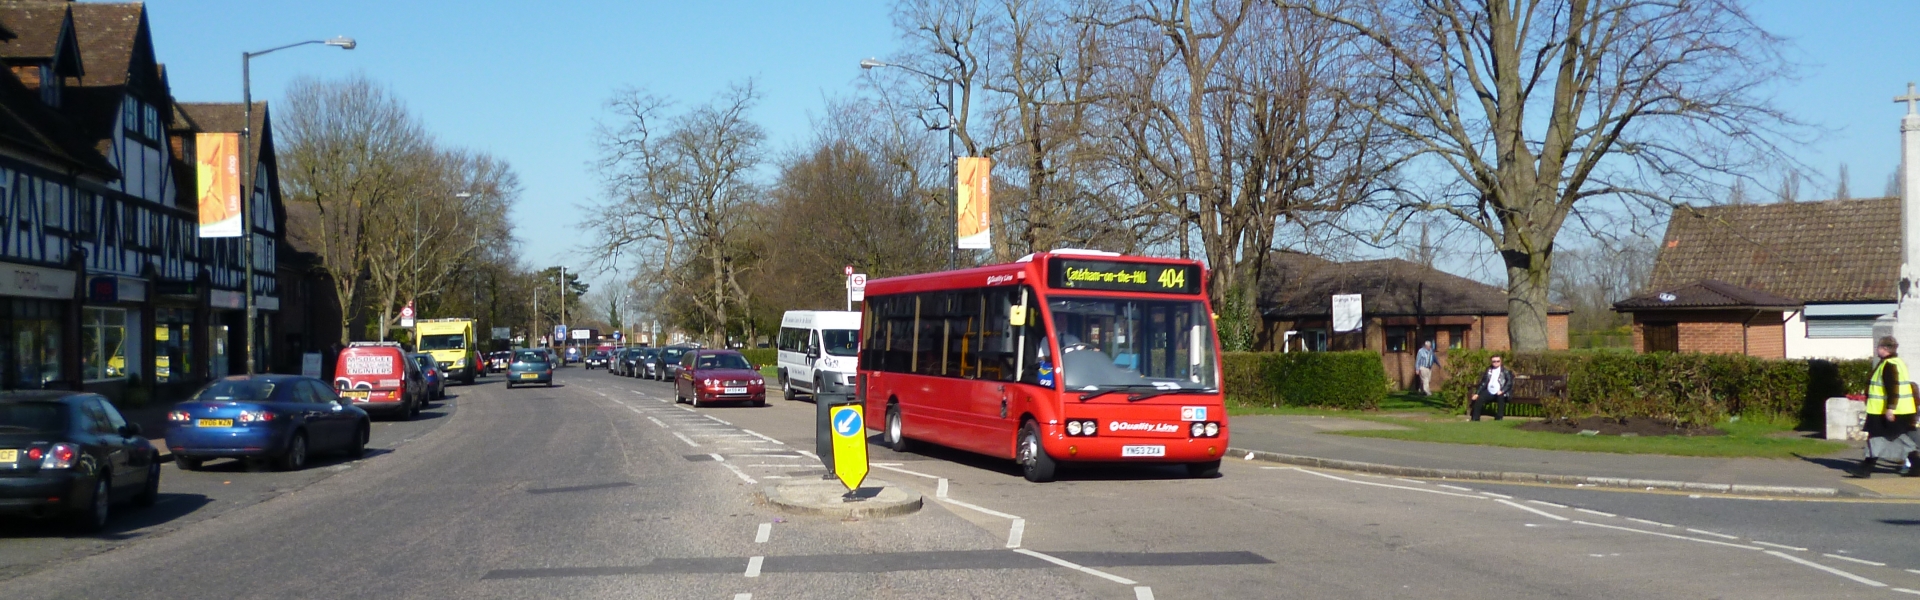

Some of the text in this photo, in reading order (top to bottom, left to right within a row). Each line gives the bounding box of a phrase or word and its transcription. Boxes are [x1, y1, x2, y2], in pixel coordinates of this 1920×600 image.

[228, 155, 237, 174] shop
[229, 195, 237, 211] Live
[1066, 267, 1185, 288] Caterham-on-the-Hill 404
[1118, 422, 1179, 432] Quality Line
